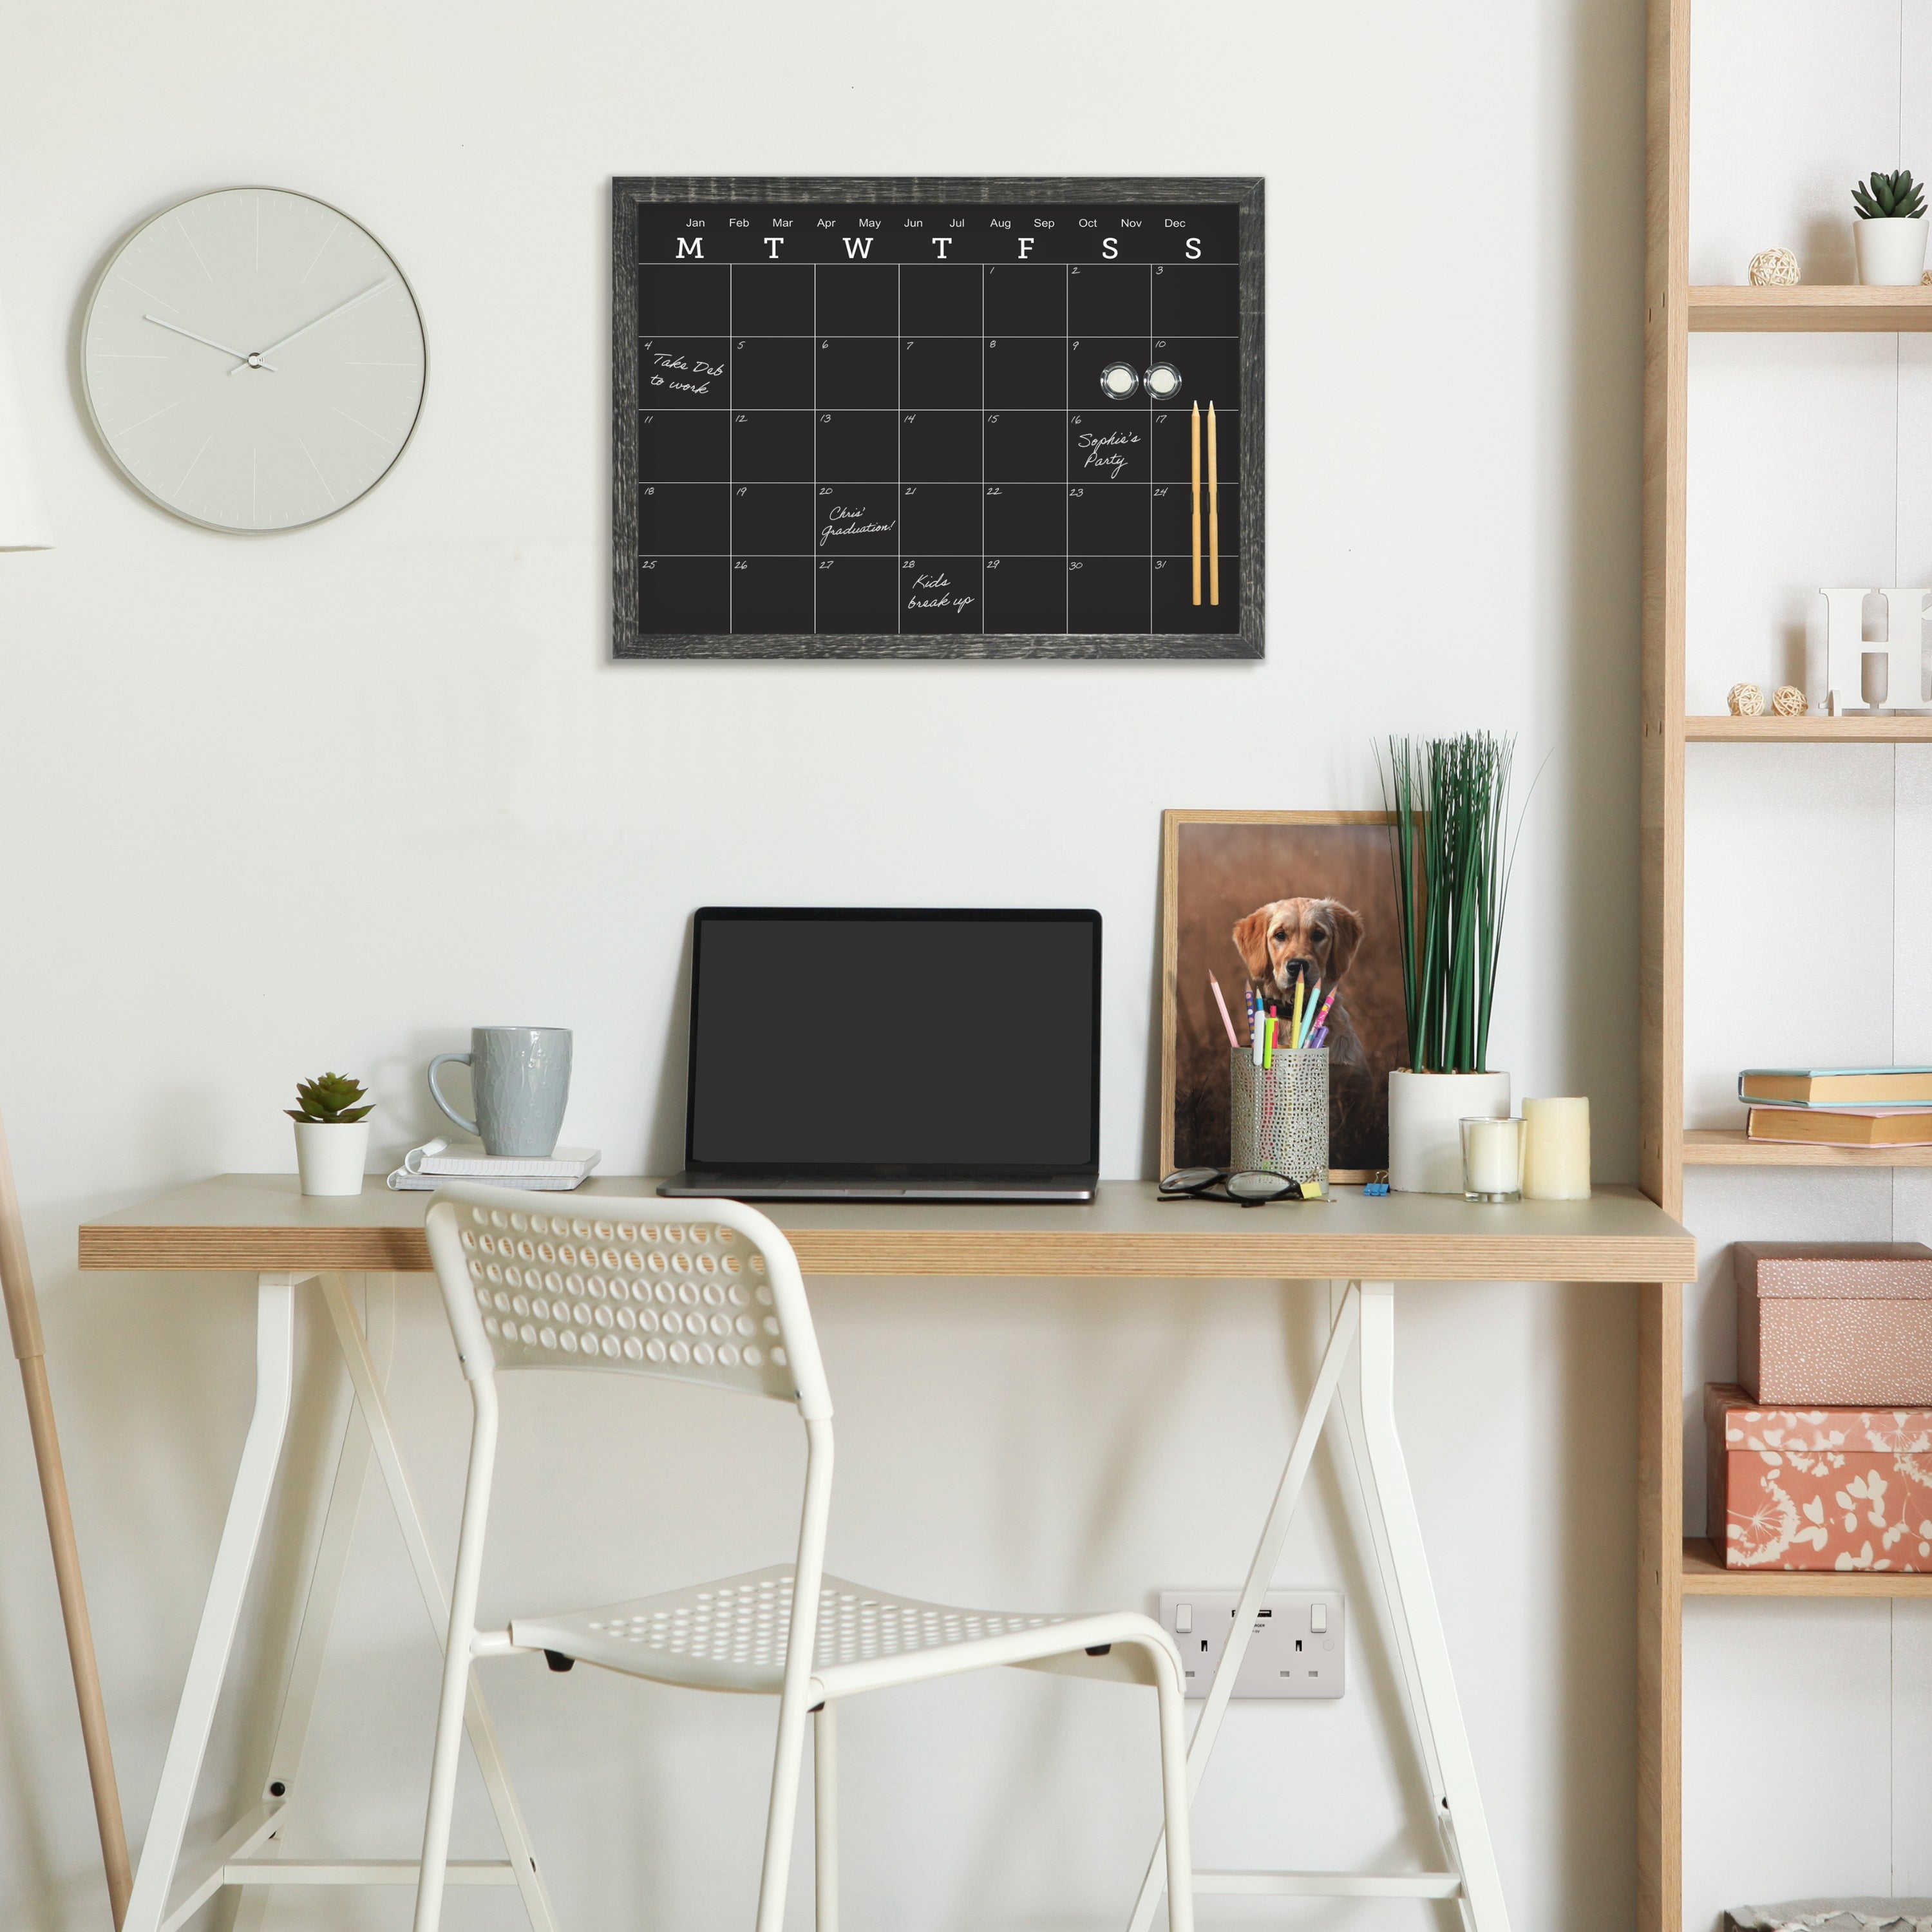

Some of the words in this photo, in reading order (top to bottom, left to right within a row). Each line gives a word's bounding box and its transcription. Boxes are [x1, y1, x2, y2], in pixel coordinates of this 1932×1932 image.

[687, 218, 705, 227] Jan
[730, 218, 749, 227] Feb
[773, 218, 793, 227] Mar
[817, 218, 836, 229] Apr
[860, 219, 881, 229] May
[990, 219, 1010, 229] Aug
[1034, 219, 1054, 229] Sep
[1079, 219, 1097, 227] Oct
[1122, 219, 1142, 227] Nov
[1165, 219, 1186, 227] Dec
[676, 238, 704, 258] M
[764, 238, 784, 258] T
[842, 238, 873, 258] W
[933, 238, 952, 258] T
[1018, 238, 1034, 258] F
[1103, 238, 1118, 259] S
[1186, 238, 1201, 259] S
[645, 341, 652, 350] 4
[822, 340, 828, 348] 6
[1073, 341, 1079, 350] 9
[654, 354, 688, 370] Take
[693, 361, 723, 375] Deb
[651, 375, 665, 385] to
[669, 381, 710, 394] work
[904, 414, 916, 423] 14
[1071, 415, 1081, 424] 16
[1078, 431, 1141, 454] Sophie's
[1084, 452, 1128, 479] Party
[737, 488, 746, 496] 19
[1153, 488, 1168, 497] 24
[829, 506, 865, 520] Chris'
[734, 561, 747, 569] 26
[987, 560, 999, 569] 29
[912, 573, 951, 589] Kids
[907, 592, 951, 609] break
[953, 596, 975, 614] up
